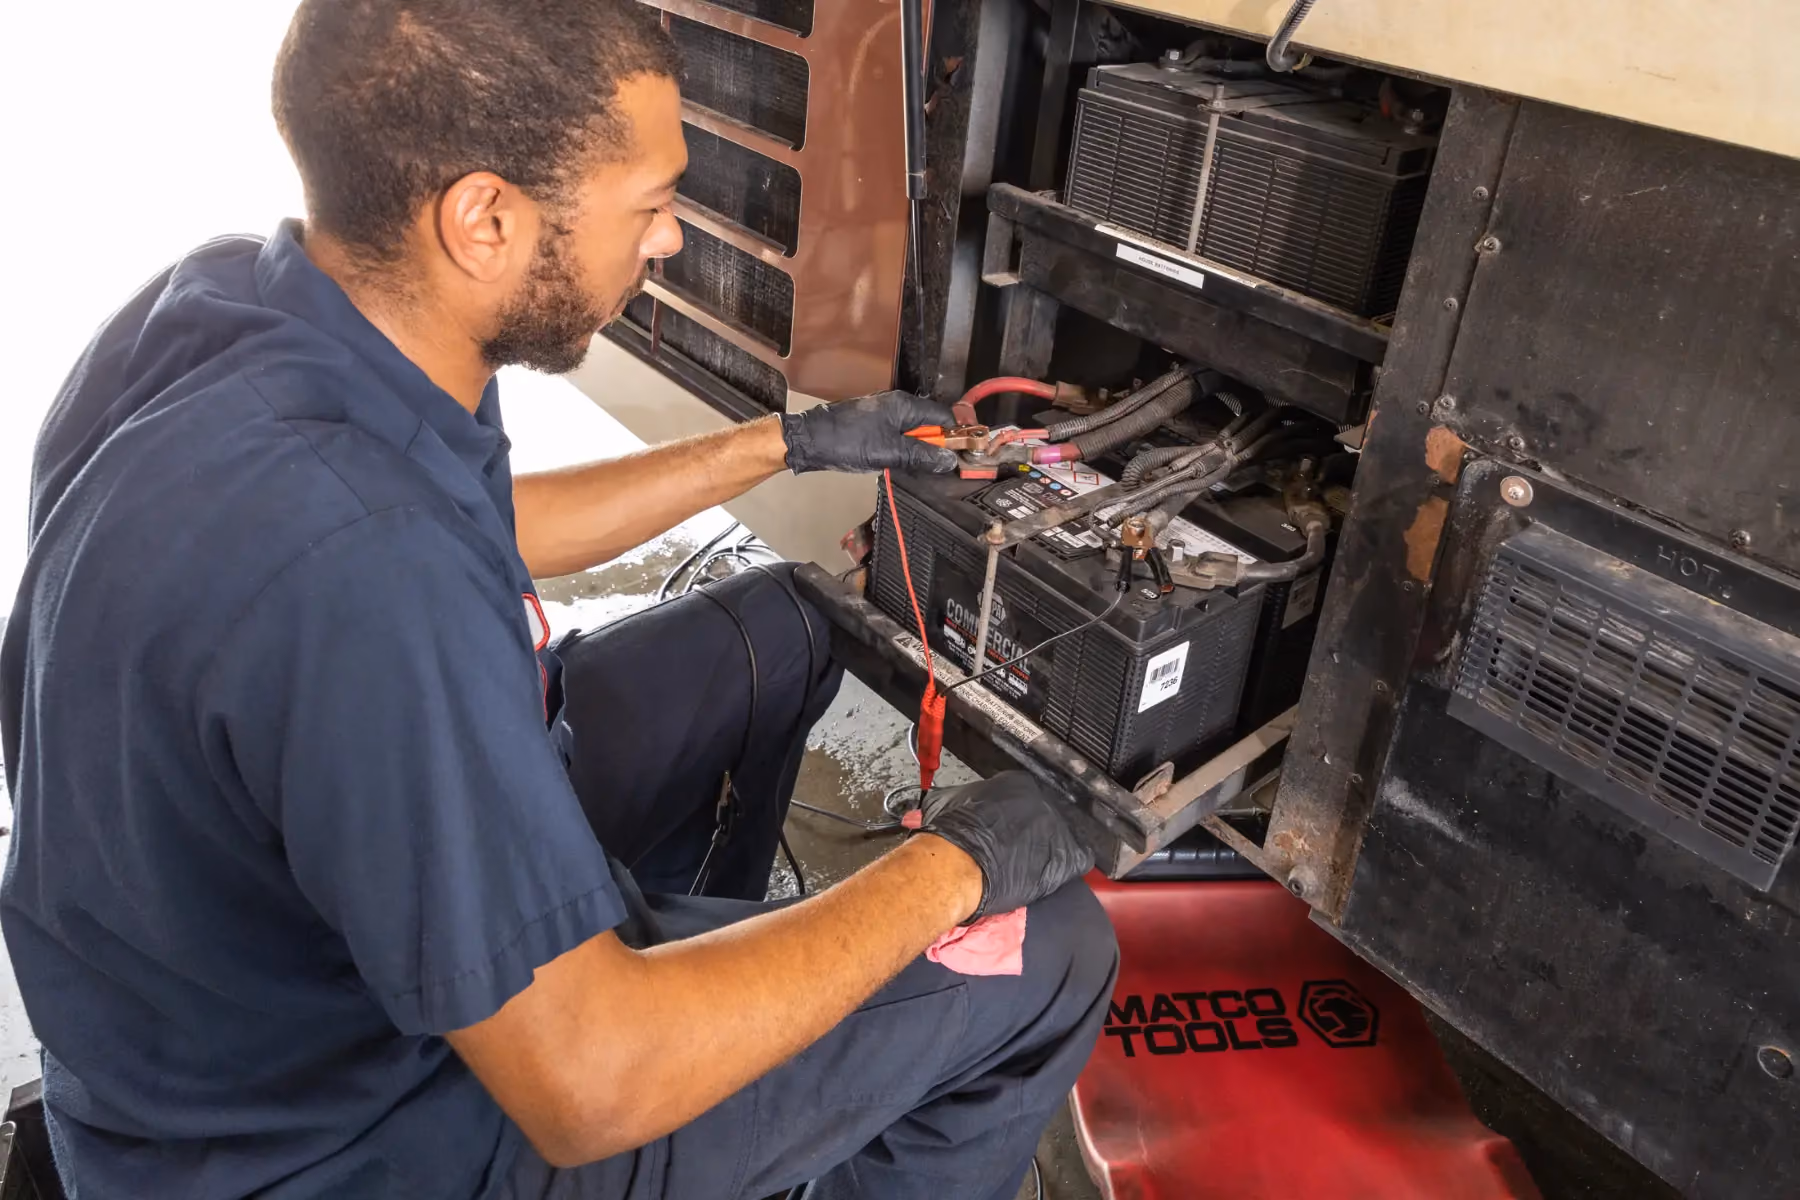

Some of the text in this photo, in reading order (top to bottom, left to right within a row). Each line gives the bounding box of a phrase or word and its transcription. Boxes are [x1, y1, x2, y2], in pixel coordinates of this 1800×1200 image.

[1657, 545, 1720, 587] HOT
[1160, 676, 1178, 691] 7236
[1104, 988, 1287, 1025] MATCO
[1104, 1017, 1298, 1057] TOOLS
